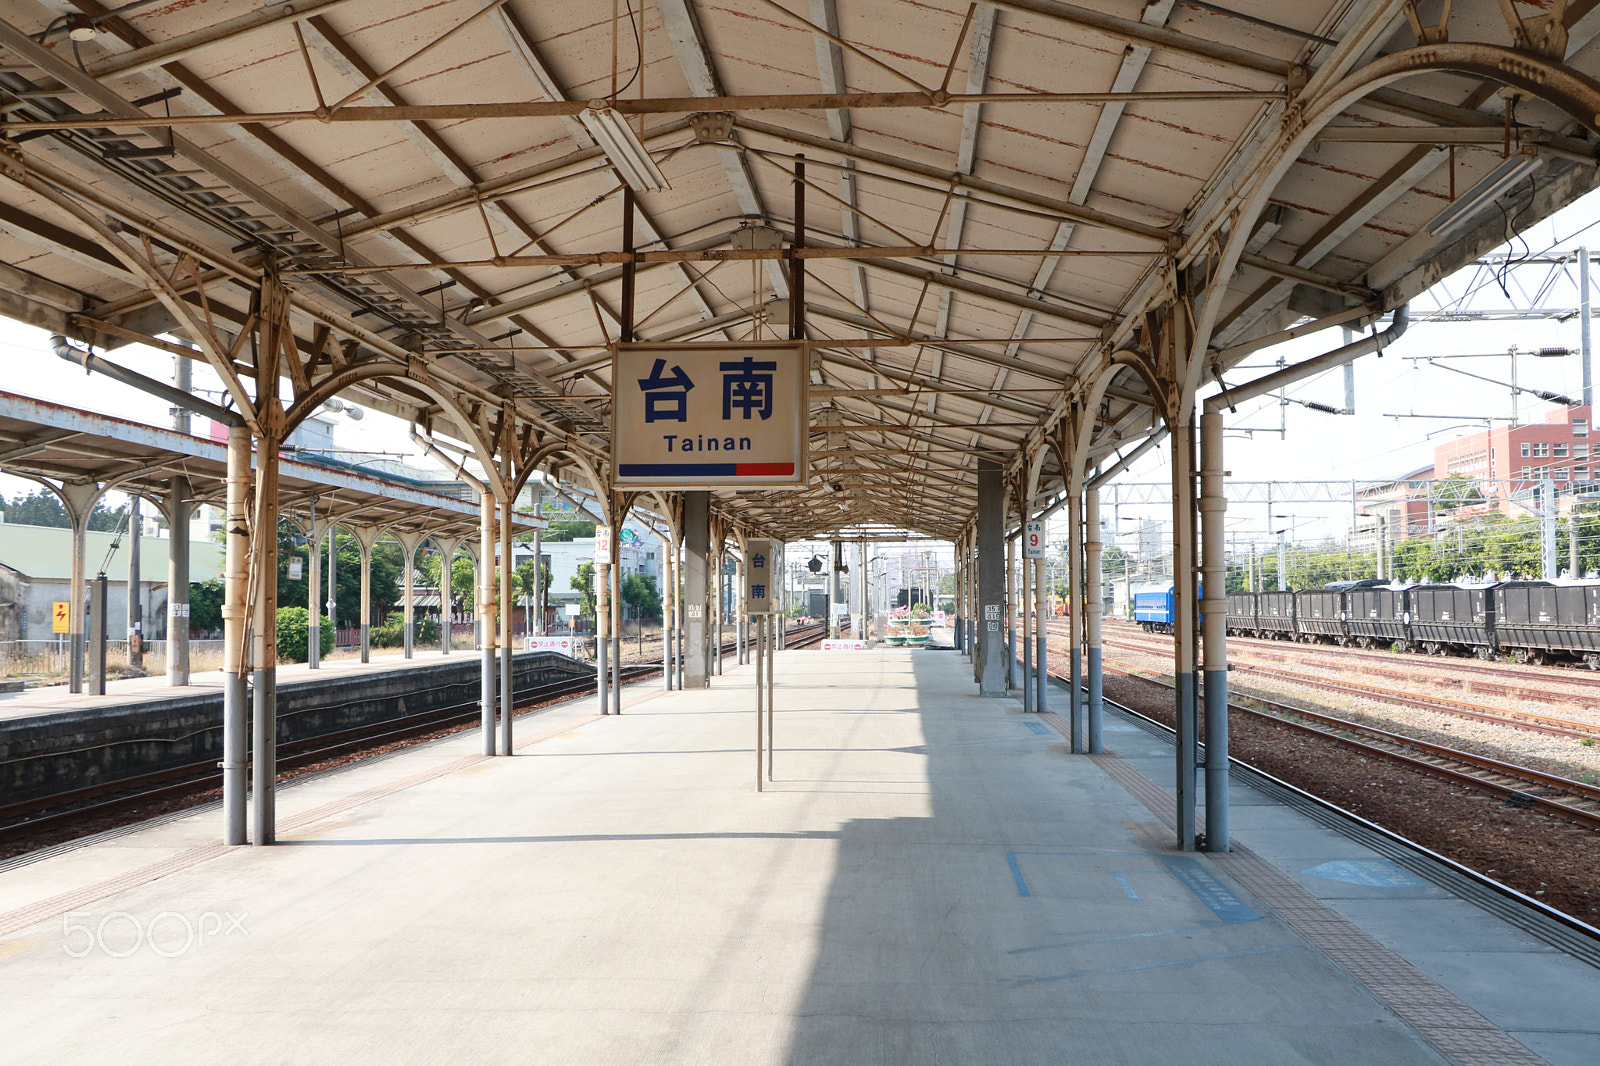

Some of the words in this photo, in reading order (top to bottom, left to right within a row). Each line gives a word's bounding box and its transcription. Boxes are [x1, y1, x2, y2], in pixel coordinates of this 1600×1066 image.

[637, 356, 777, 424] 台南
[663, 434, 752, 453] Tainan
[597, 539, 608, 550] 12
[1030, 534, 1038, 546] 9
[751, 552, 766, 599] 台南
